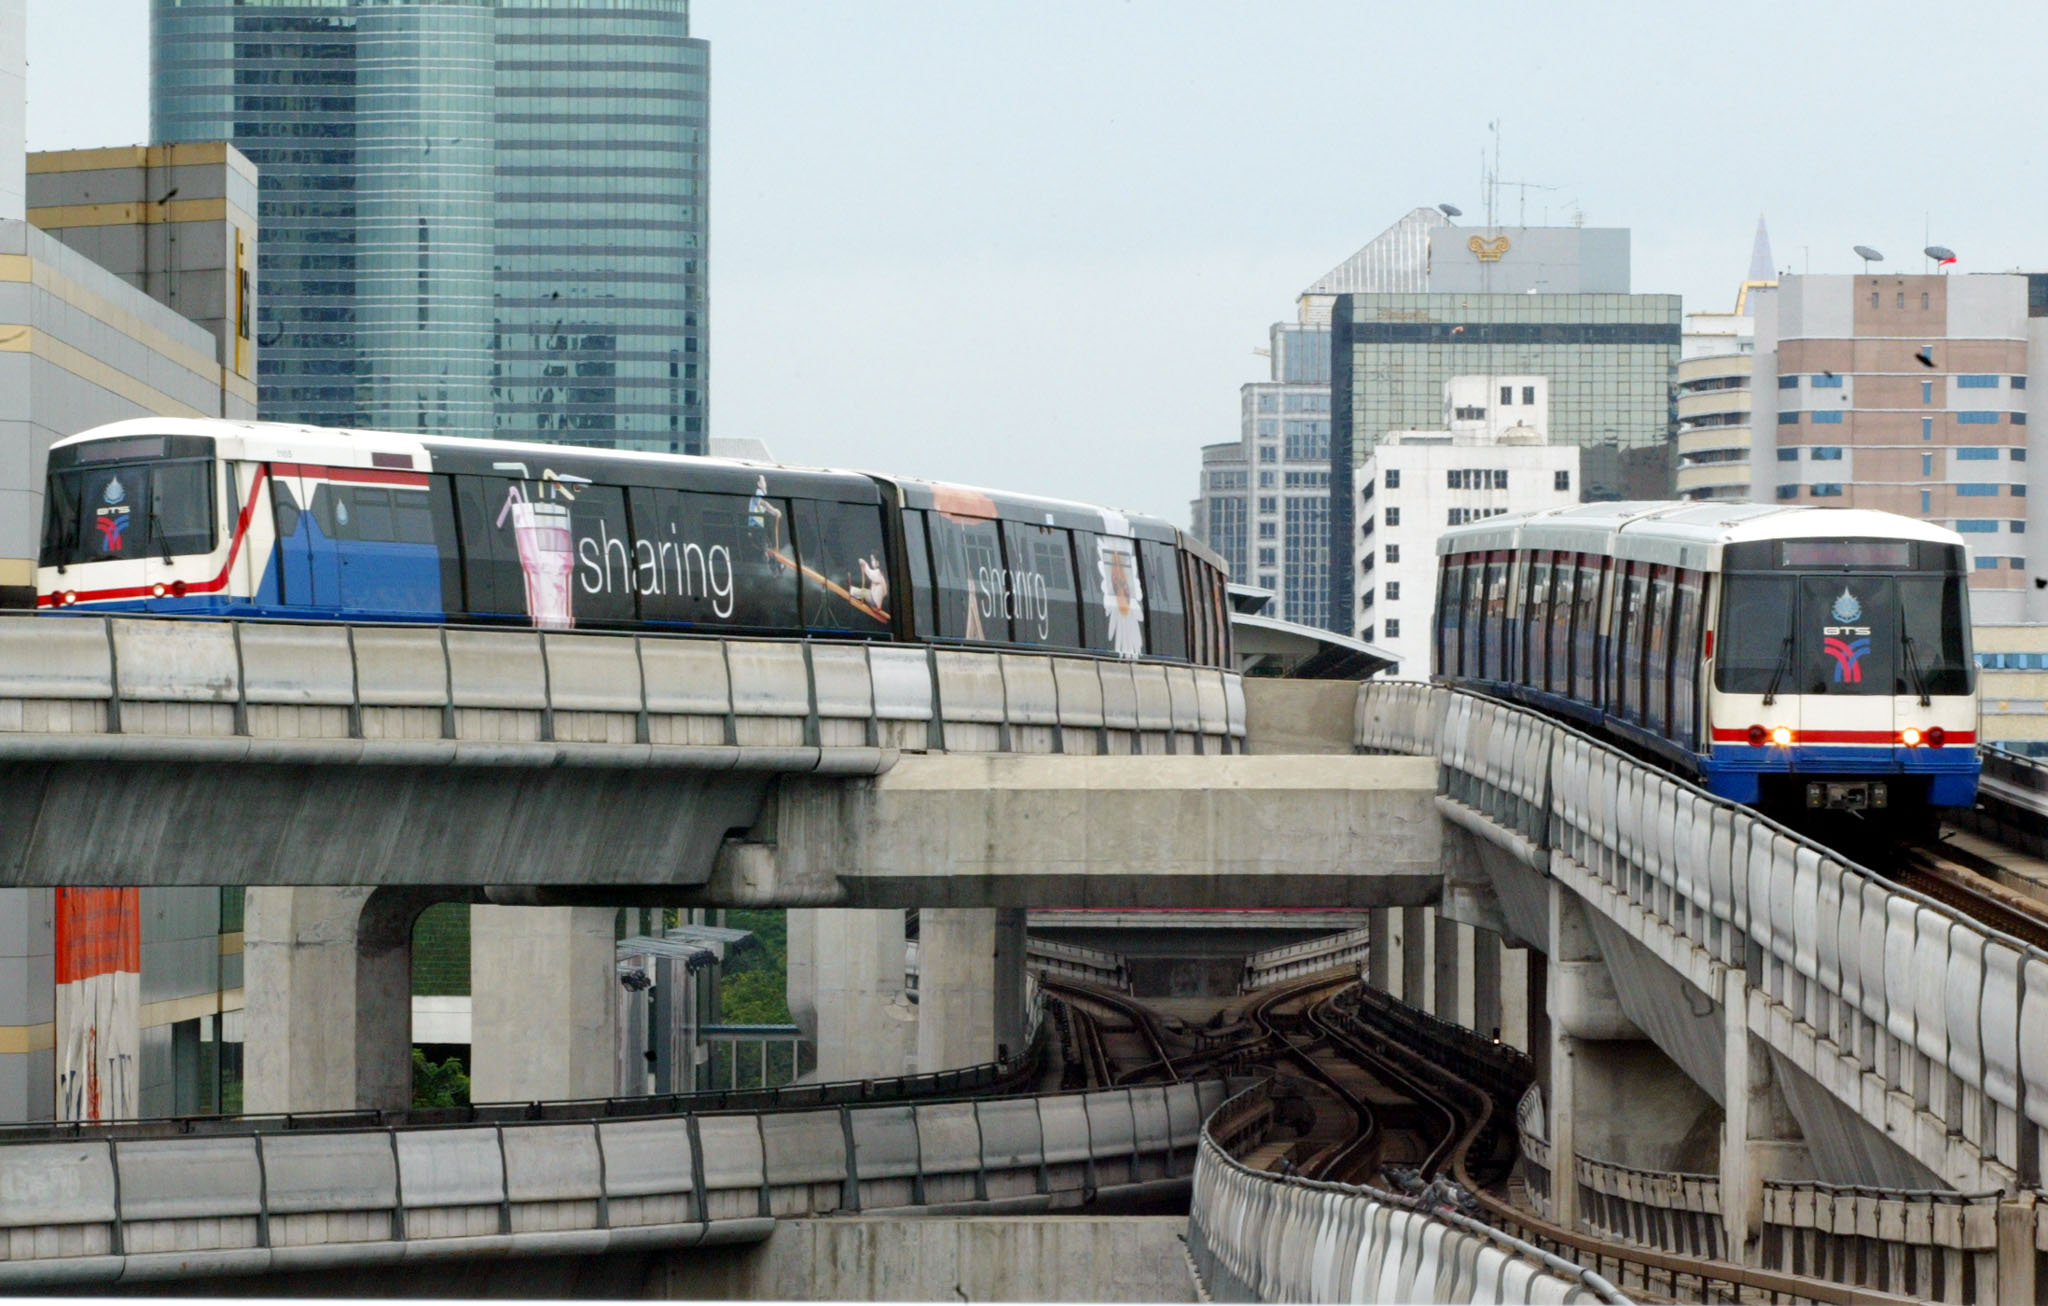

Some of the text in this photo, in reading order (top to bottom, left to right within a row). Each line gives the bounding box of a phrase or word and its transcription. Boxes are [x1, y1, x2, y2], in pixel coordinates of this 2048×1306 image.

[97, 506, 130, 515] BTS
[578, 519, 734, 619] sharing
[979, 548, 1049, 640] sharing
[1823, 626, 1871, 636] BTS
